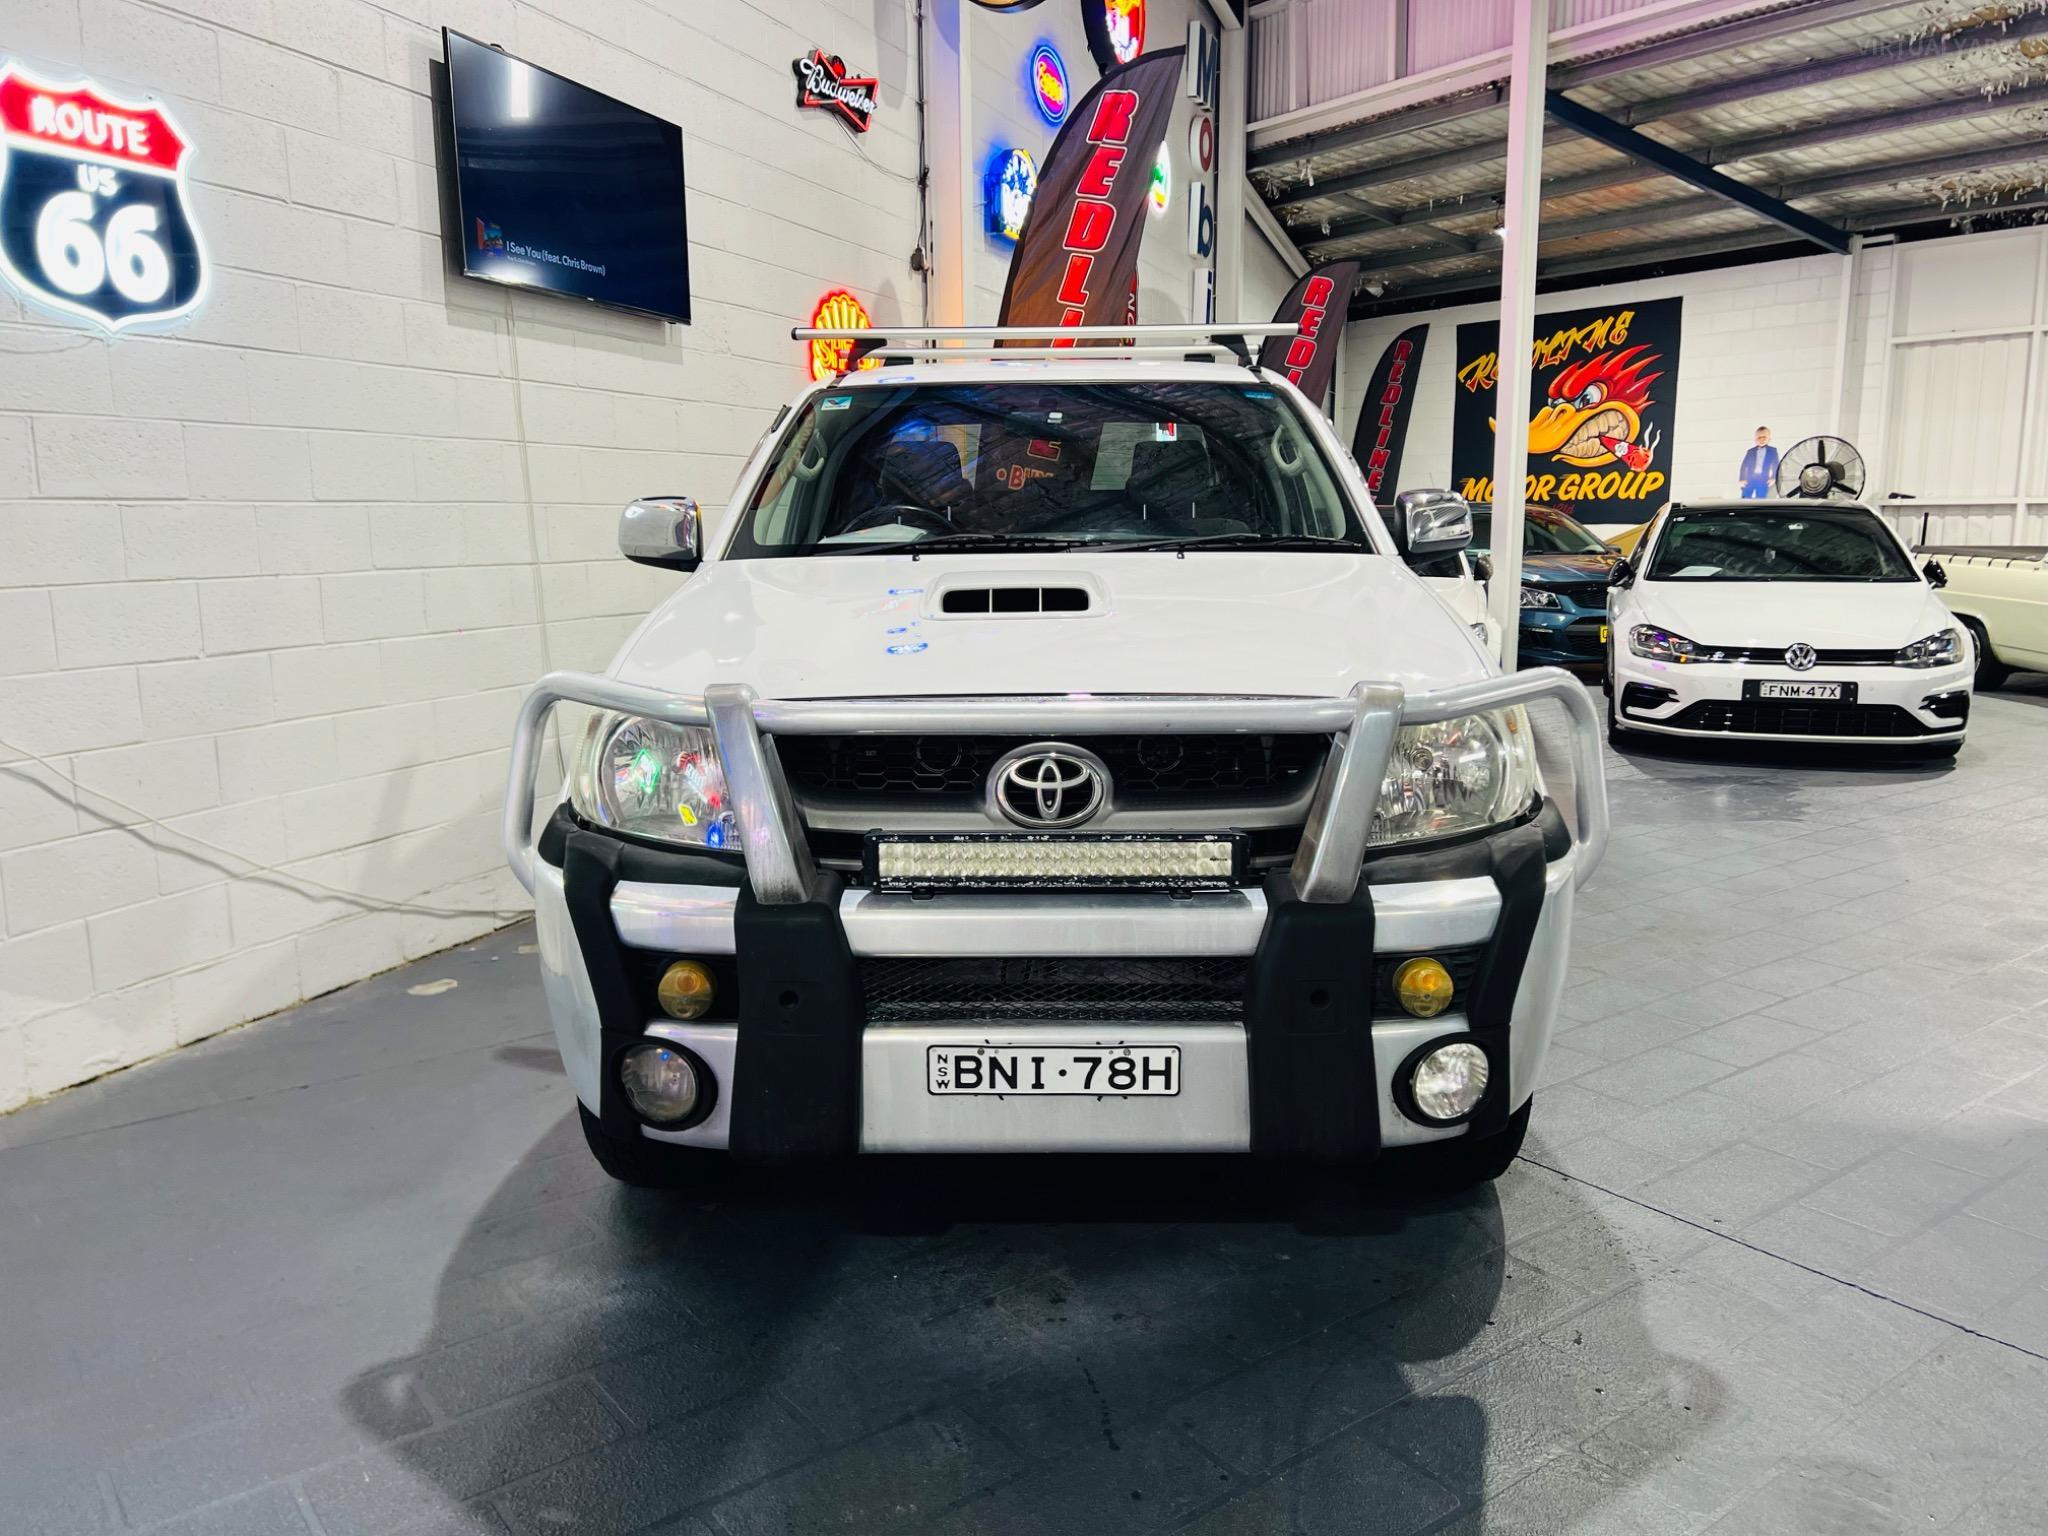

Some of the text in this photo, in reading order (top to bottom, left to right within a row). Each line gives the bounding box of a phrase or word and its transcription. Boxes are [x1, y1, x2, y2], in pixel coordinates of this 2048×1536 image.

[30, 96, 151, 156] ROUTE
[77, 163, 120, 197] US
[36, 190, 170, 303] 66
[510, 242, 525, 256] See
[526, 245, 541, 260] You
[542, 250, 562, 265] (feat.
[562, 255, 580, 270] Chris
[580, 260, 606, 277] Brown)
[1368, 339, 1414, 493] REDLINE
[1557, 471, 1665, 501] GROUP
[936, 1054, 951, 1090] NSW
